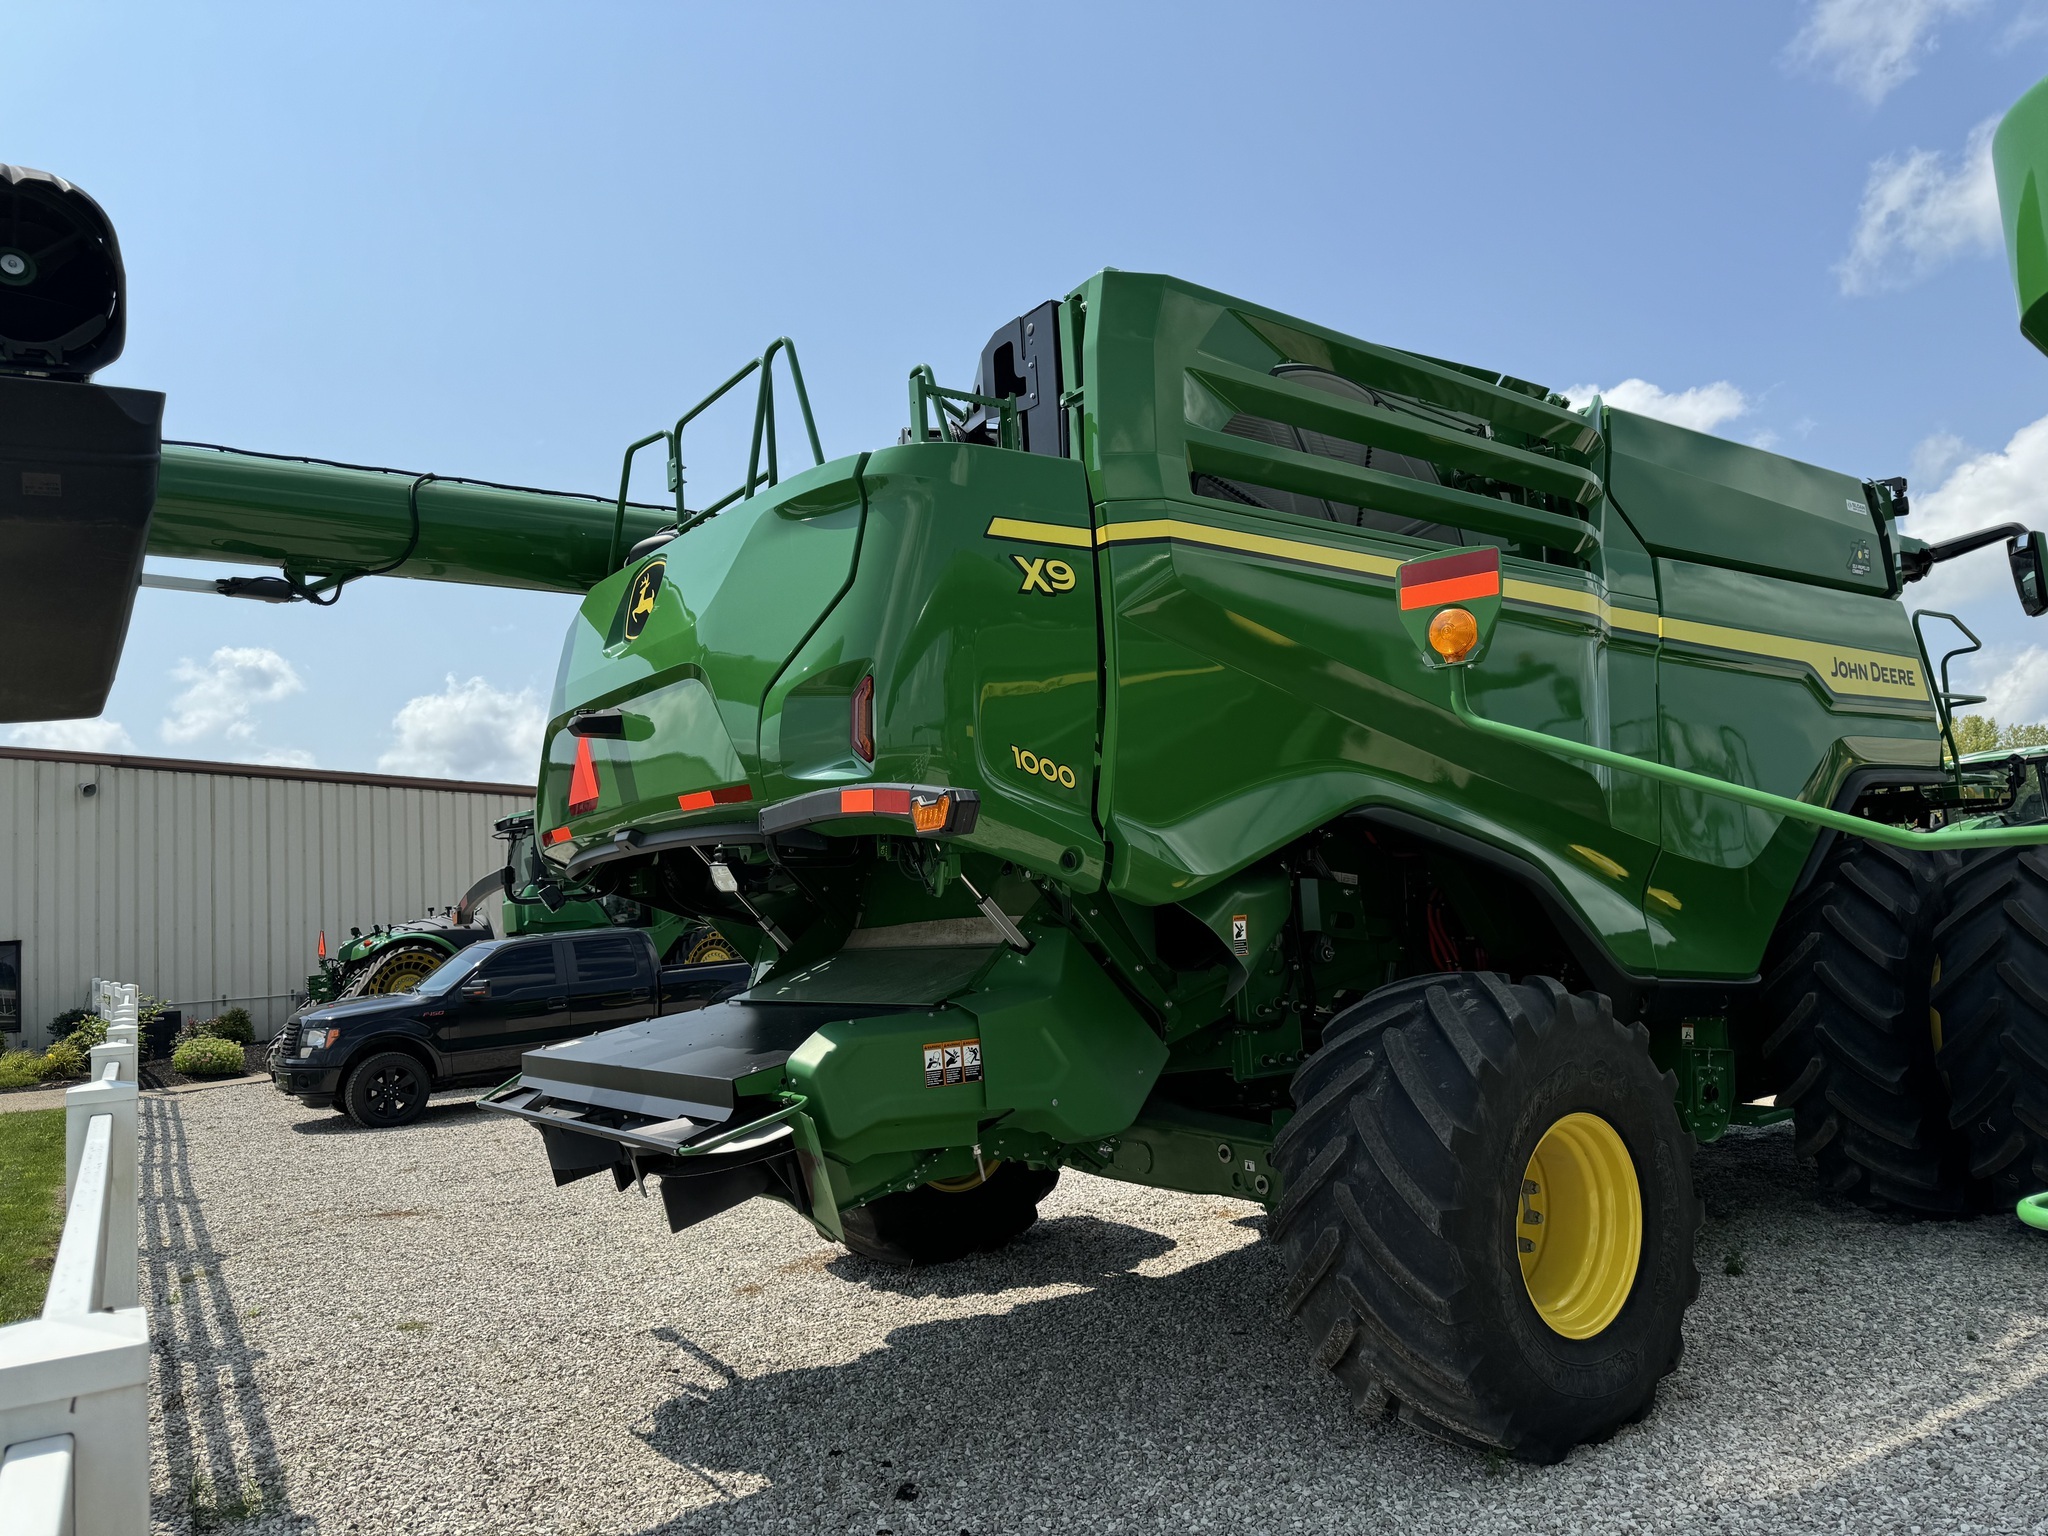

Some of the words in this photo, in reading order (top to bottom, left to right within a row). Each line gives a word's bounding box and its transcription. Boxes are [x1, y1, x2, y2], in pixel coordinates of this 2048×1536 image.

[1010, 554, 1076, 593] X9
[1831, 656, 1868, 680] JOHN
[1870, 661, 1915, 686] DEERE
[1010, 744, 1076, 789] 1000
